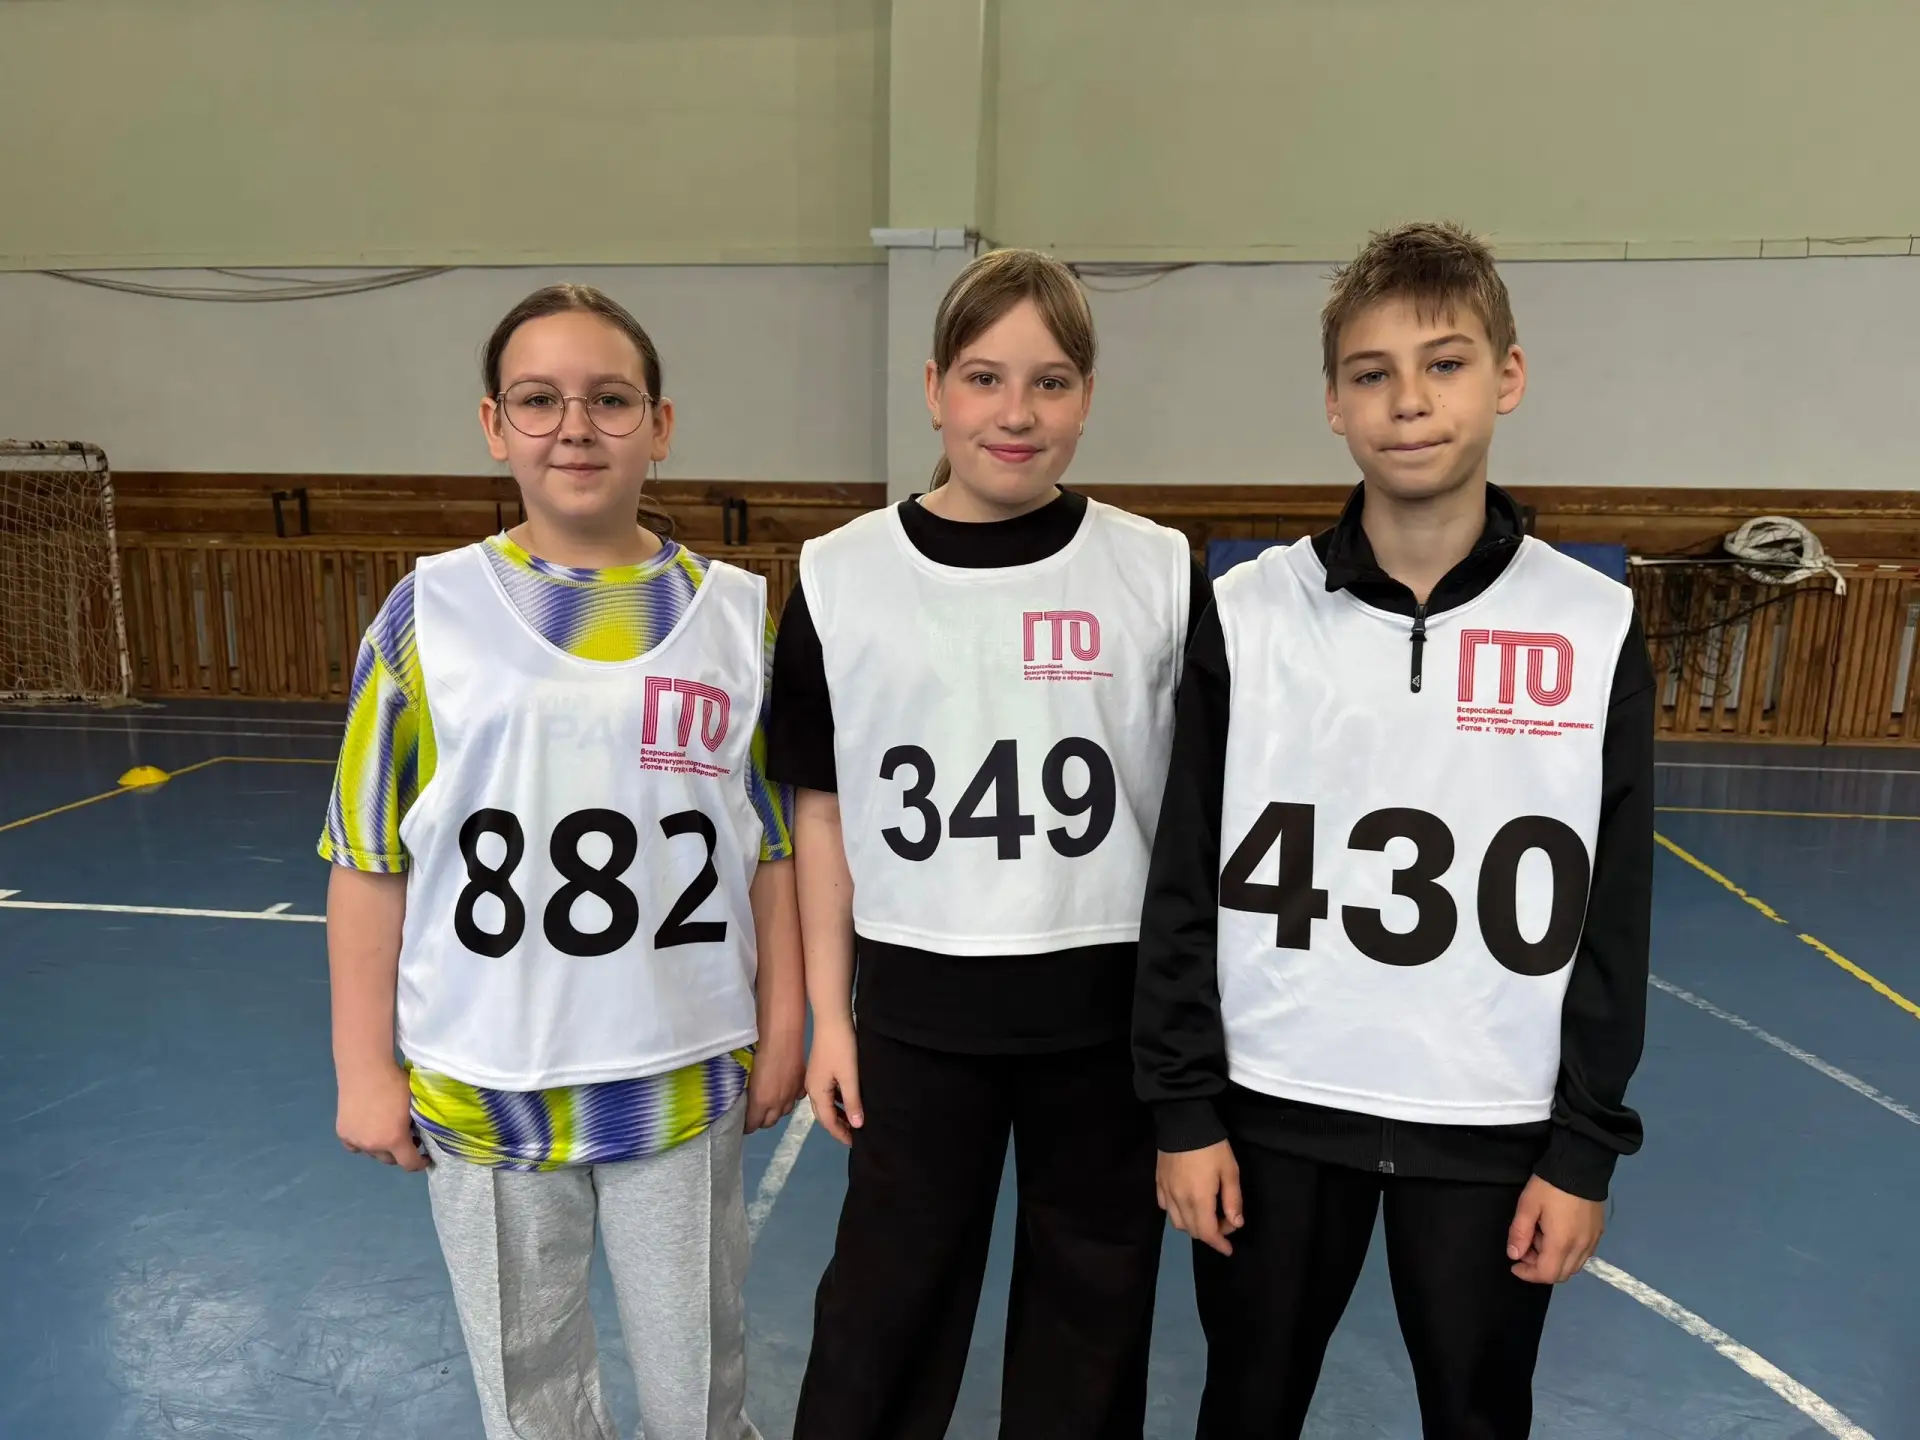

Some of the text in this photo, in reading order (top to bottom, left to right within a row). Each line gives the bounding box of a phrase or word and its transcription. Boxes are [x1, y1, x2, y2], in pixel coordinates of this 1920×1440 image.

[1023, 611, 1101, 661] ГТО
[1458, 629, 1574, 706] ГТО
[641, 676, 731, 752] ГТО
[1456, 715, 1594, 730] физкультурно-спортивный комплекс
[1456, 724, 1482, 732] «Готов
[1494, 727, 1516, 735] труду
[1528, 729, 1562, 737] обороне»
[1457, 706, 1513, 715] Всероссийский
[879, 737, 1117, 861] 349
[454, 808, 728, 958] 882
[1219, 801, 1591, 976] 430
